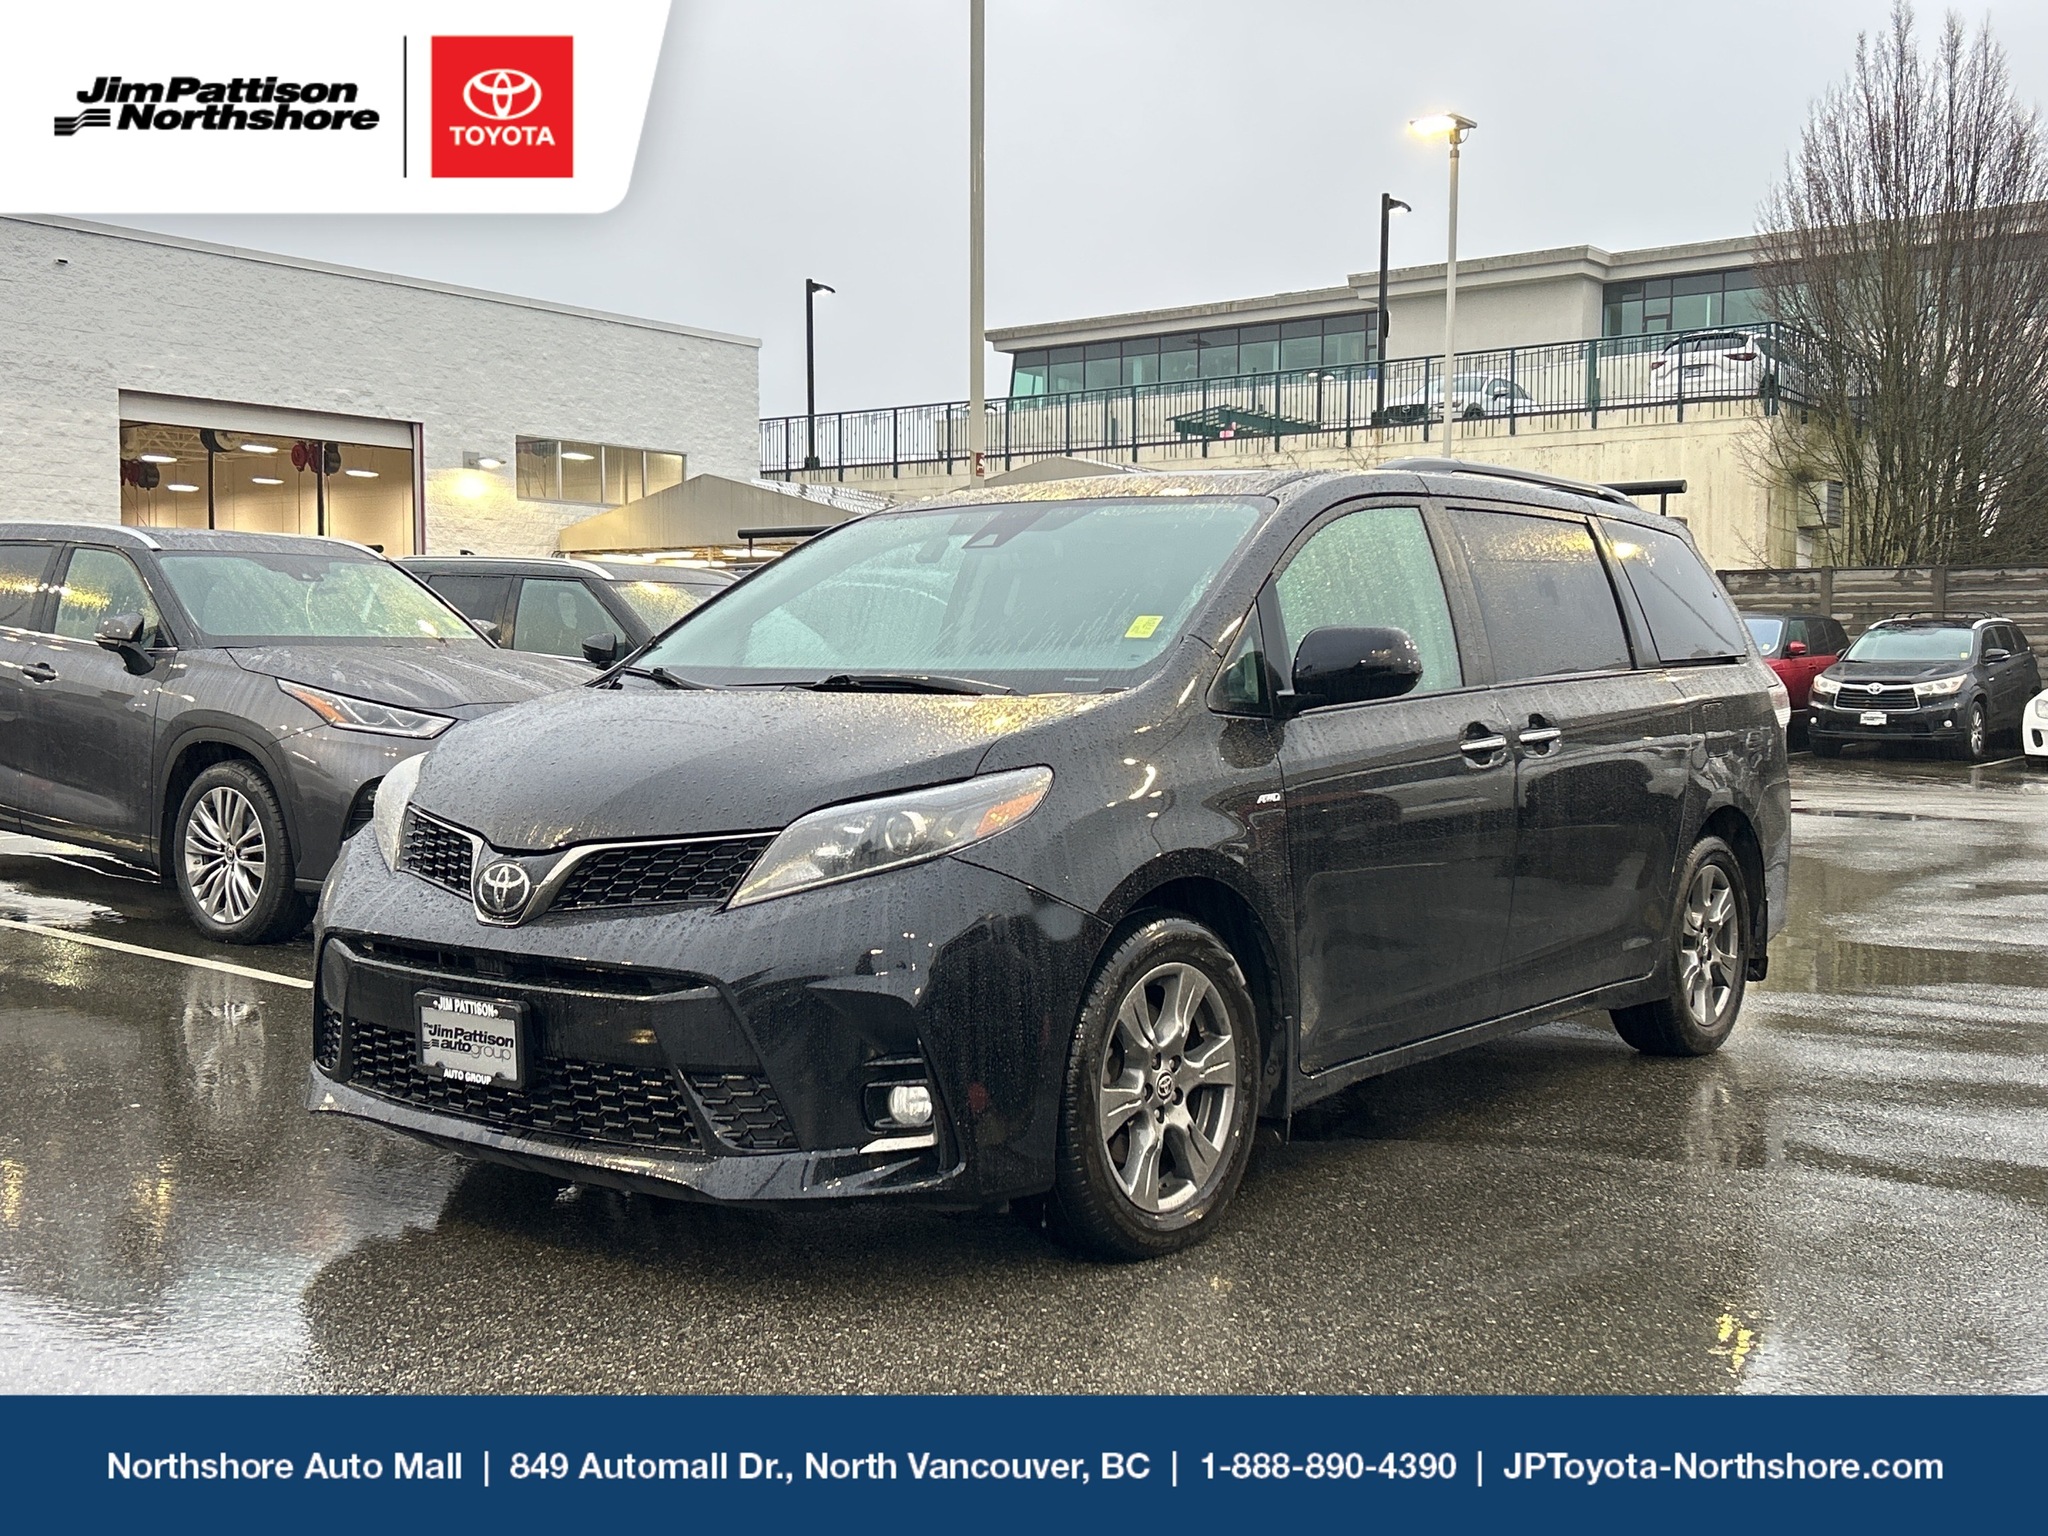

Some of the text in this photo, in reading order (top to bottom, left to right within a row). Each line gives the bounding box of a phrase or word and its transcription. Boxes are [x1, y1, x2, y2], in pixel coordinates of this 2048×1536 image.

[438, 996, 495, 1018] JIM PATTISON
[443, 1068, 492, 1085] AUTO GROUP
